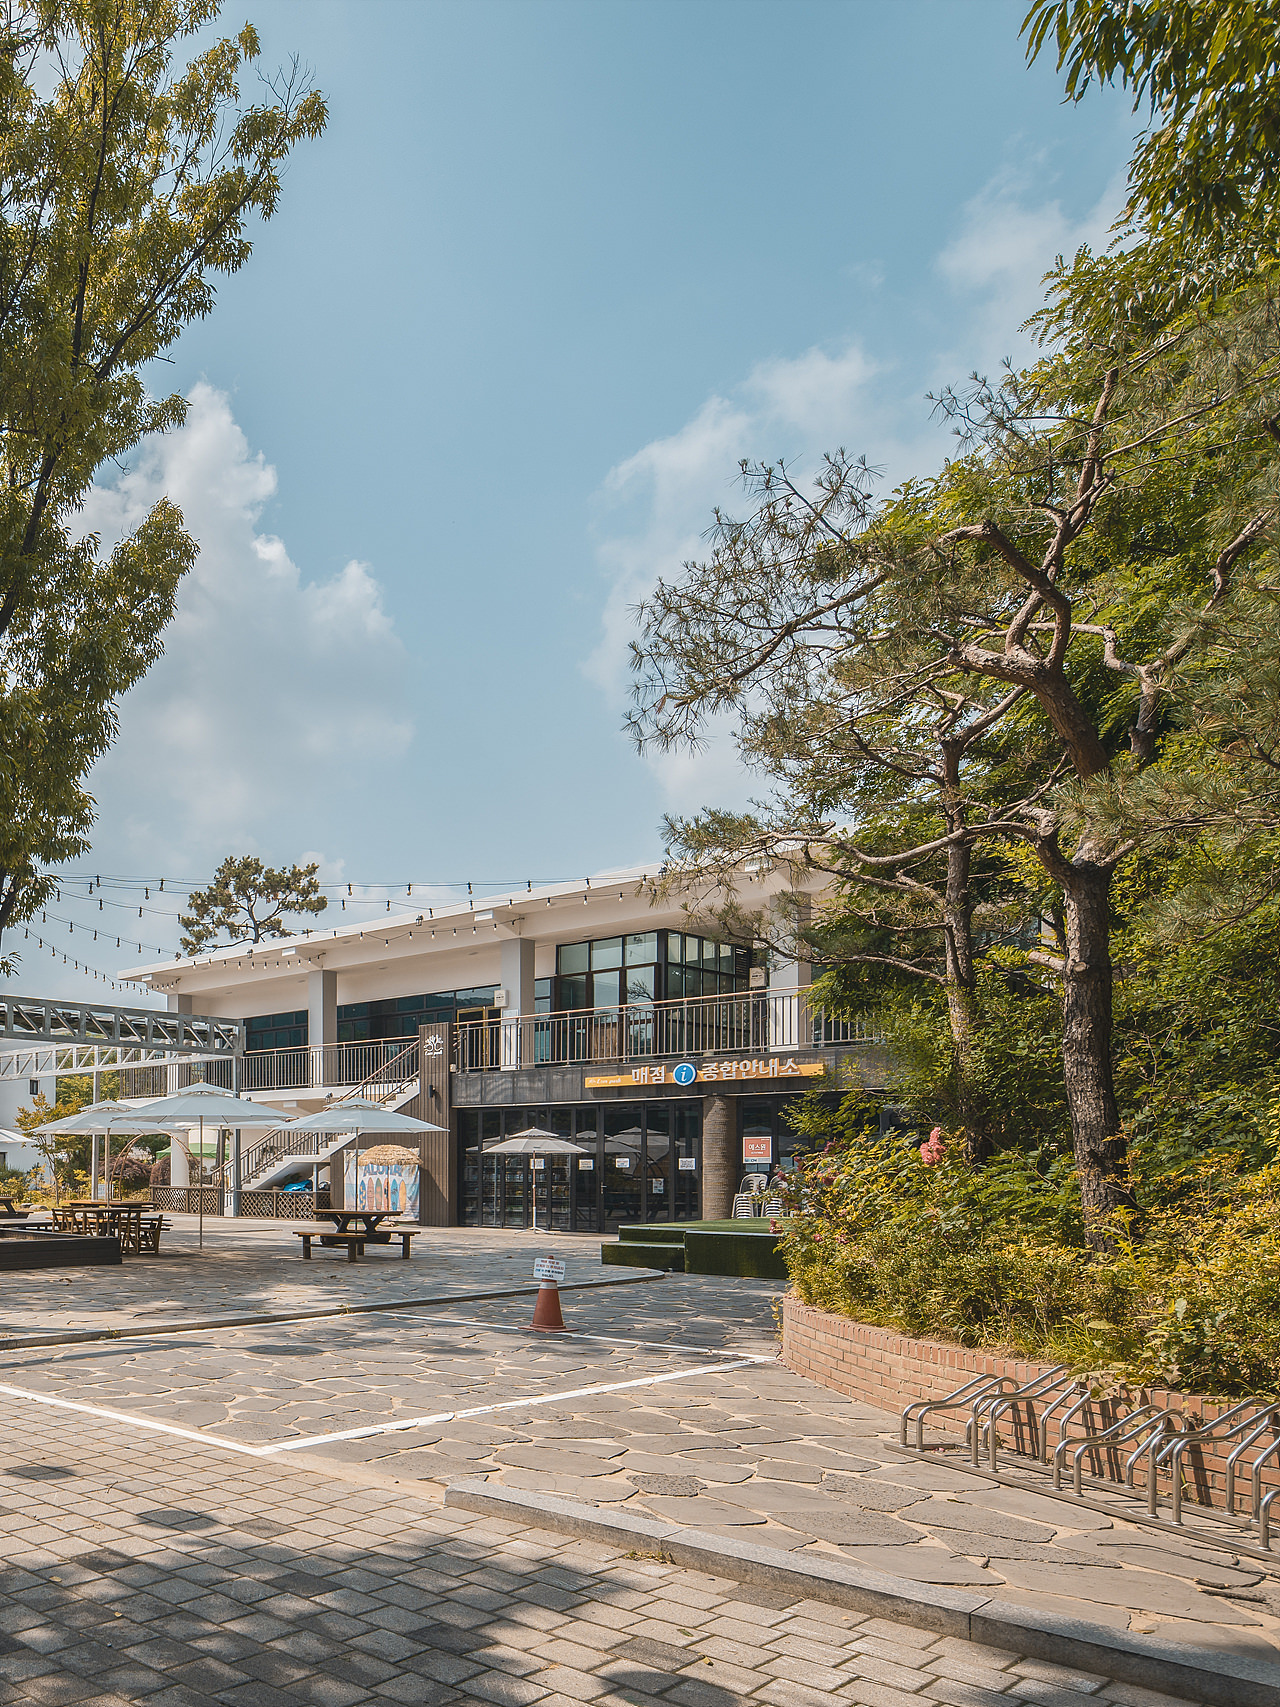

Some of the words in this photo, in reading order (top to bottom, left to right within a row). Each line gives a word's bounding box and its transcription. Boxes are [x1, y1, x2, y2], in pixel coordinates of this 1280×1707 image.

[632, 1066, 665, 1083] 매점
[701, 1058, 800, 1080] 종합안내소
[748, 1143, 767, 1151] 에스원
